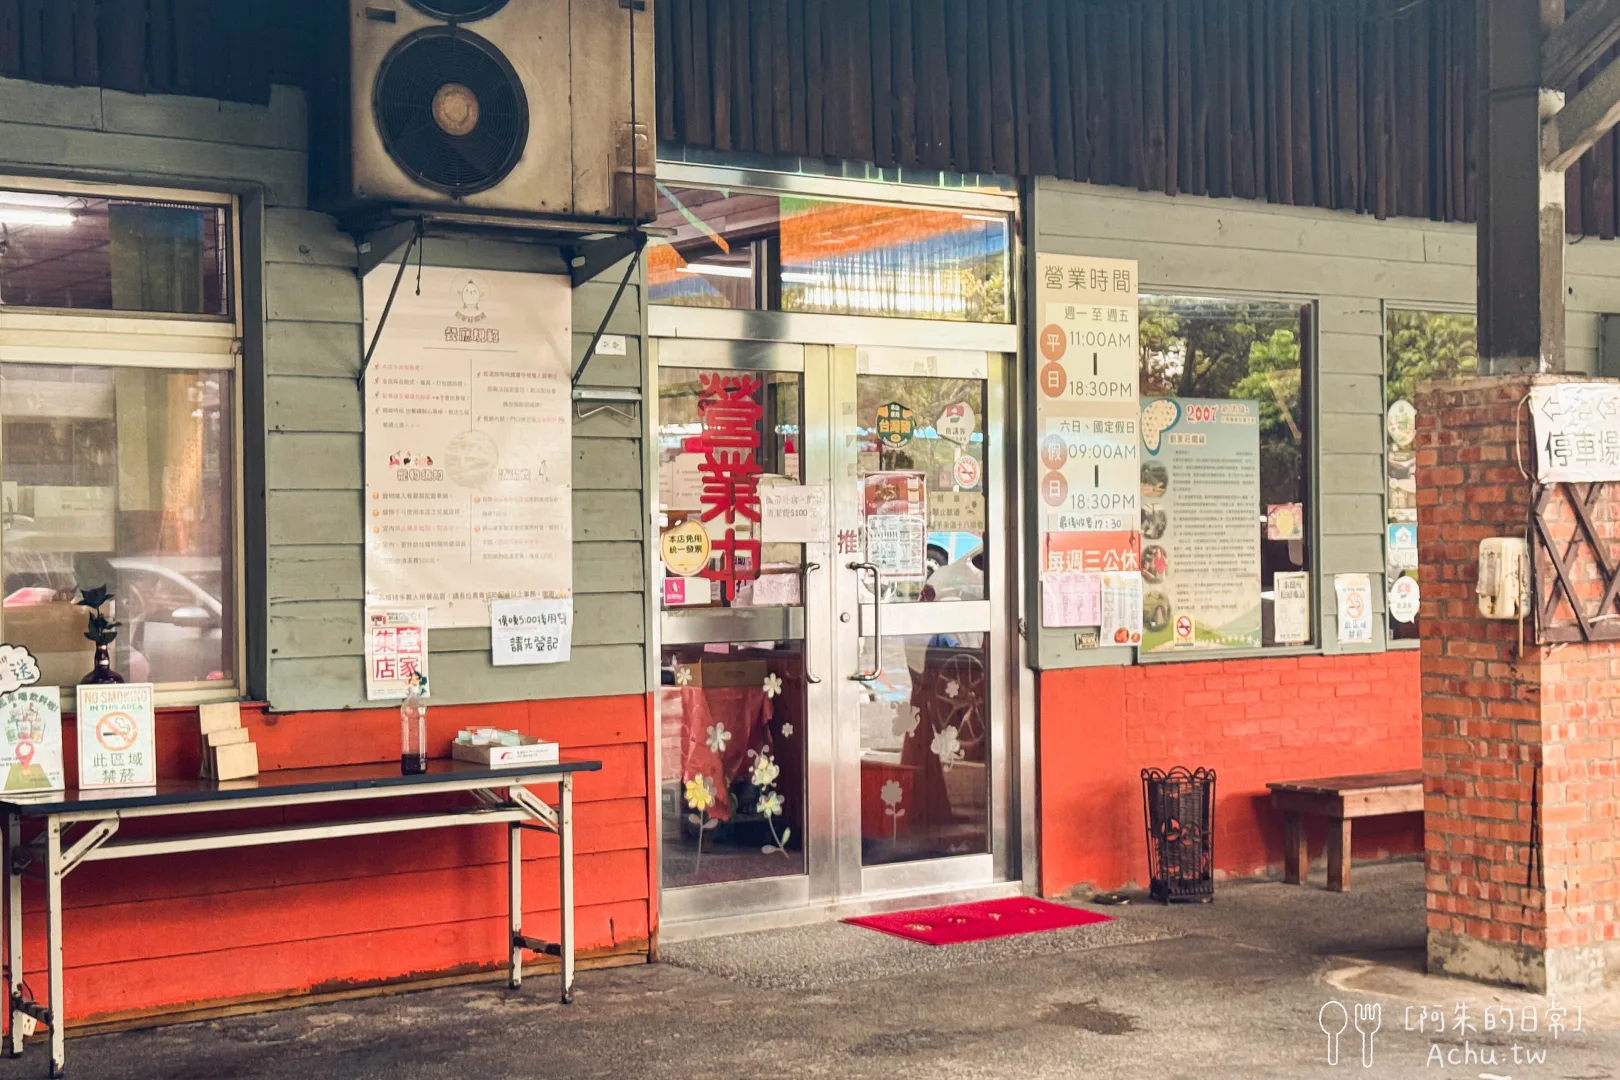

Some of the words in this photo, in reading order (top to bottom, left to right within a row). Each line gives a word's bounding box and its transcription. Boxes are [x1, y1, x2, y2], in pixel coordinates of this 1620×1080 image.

[1045, 265, 1131, 293] 營業時間
[1069, 331, 1131, 348] 11:00AM
[1069, 381, 1132, 397] 18:30PM
[1187, 405, 1218, 422] 2007
[1060, 420, 1135, 434] 六日、國定假日
[1069, 444, 1136, 459] 09:00AM
[1545, 431, 1620, 468] 停車場
[697, 372, 763, 601] 營業中
[1071, 493, 1136, 509] 18:30PM
[668, 534, 703, 544] 本店免用
[837, 530, 858, 554] 推
[669, 545, 703, 554] 統一發票
[1049, 549, 1138, 572] 每週三公休
[510, 636, 559, 652] 請先登記
[85, 691, 98, 703] NO
[101, 689, 148, 703] SMOKING
[93, 752, 143, 767] 此區域
[102, 768, 135, 783] 禁菸
